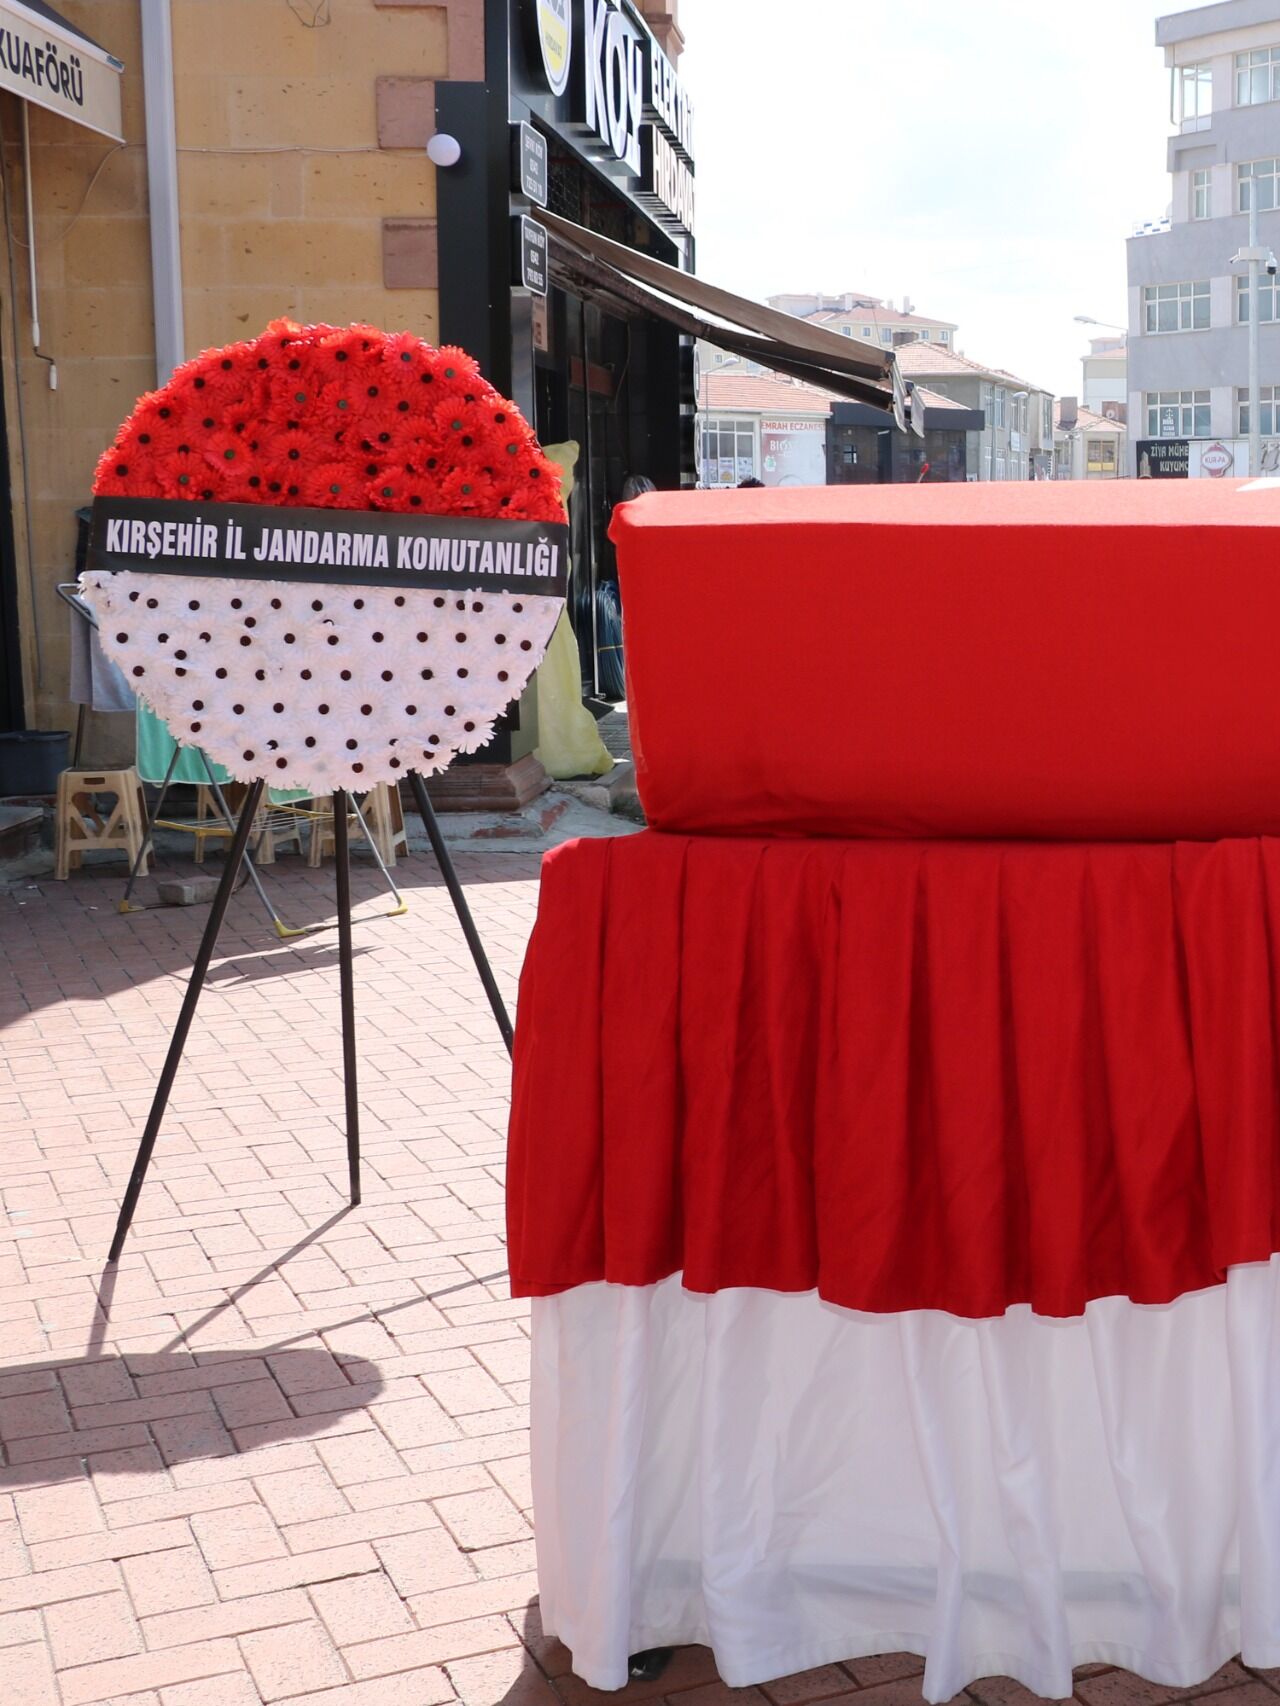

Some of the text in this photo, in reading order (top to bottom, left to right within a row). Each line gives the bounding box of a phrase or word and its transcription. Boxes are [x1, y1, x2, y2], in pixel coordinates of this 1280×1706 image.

[106, 517, 558, 577] KIRŞEHİR İL JANDARMA KOMUTANLIĞI
